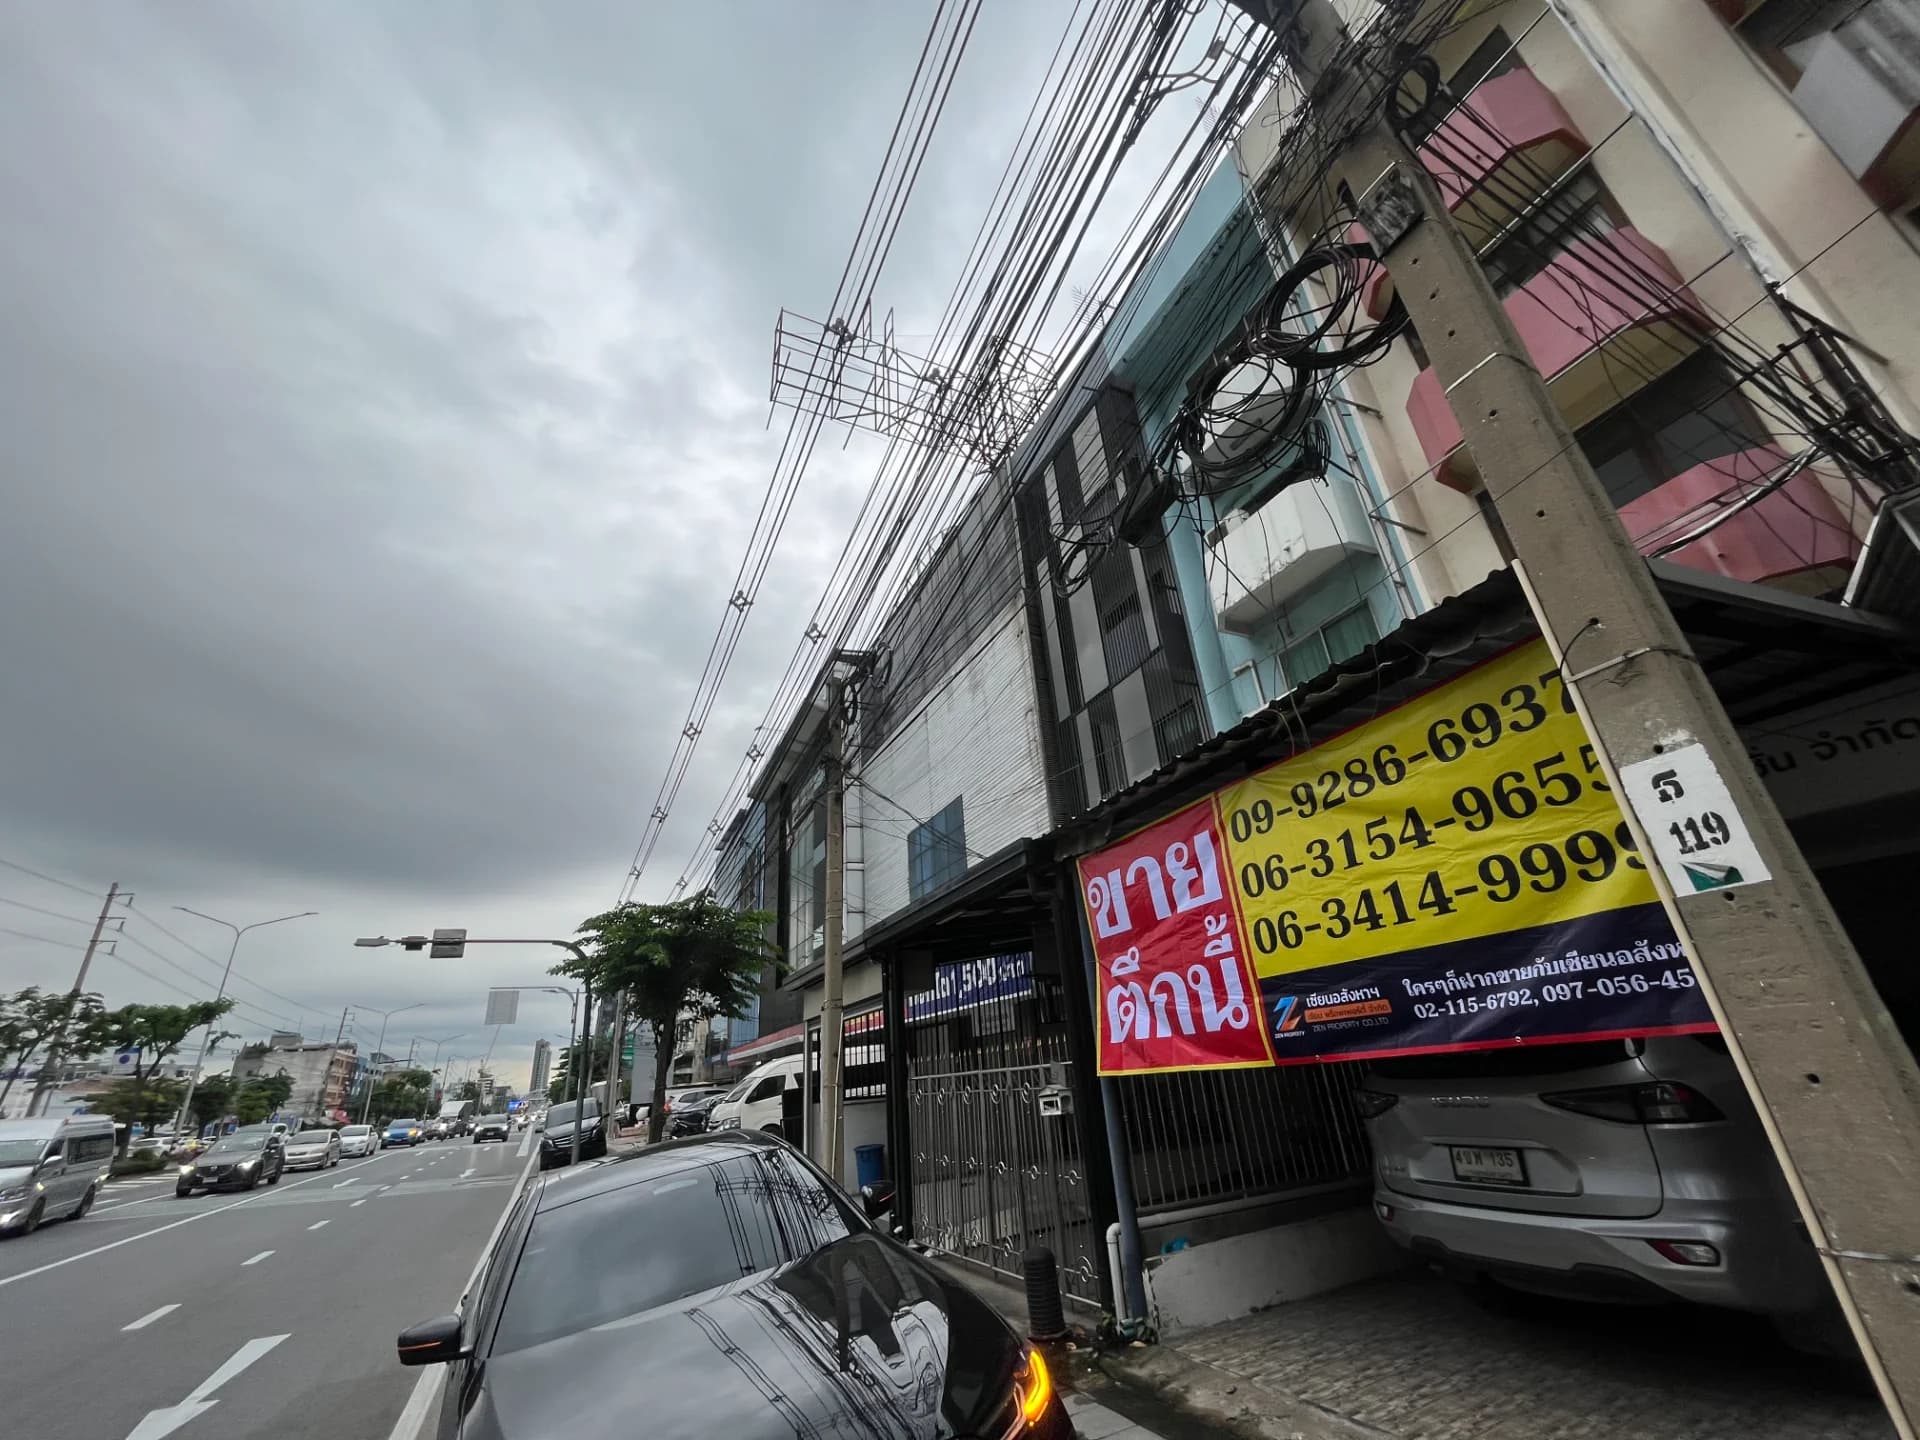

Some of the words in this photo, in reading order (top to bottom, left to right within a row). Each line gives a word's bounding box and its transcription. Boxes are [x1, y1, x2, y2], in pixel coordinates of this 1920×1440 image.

[1230, 668, 1578, 844] 09-9286-6937
[1669, 811, 1730, 855] 119
[1086, 830, 1225, 939] ขาย
[1106, 913, 1250, 1045] ตึกนี้
[1414, 989, 1539, 1019] 02-115-6792,
[1542, 968, 1695, 1003] 097-056-45
[1327, 1020, 1360, 1031] PROPERTY
[1490, 1152, 1514, 1167] 135
